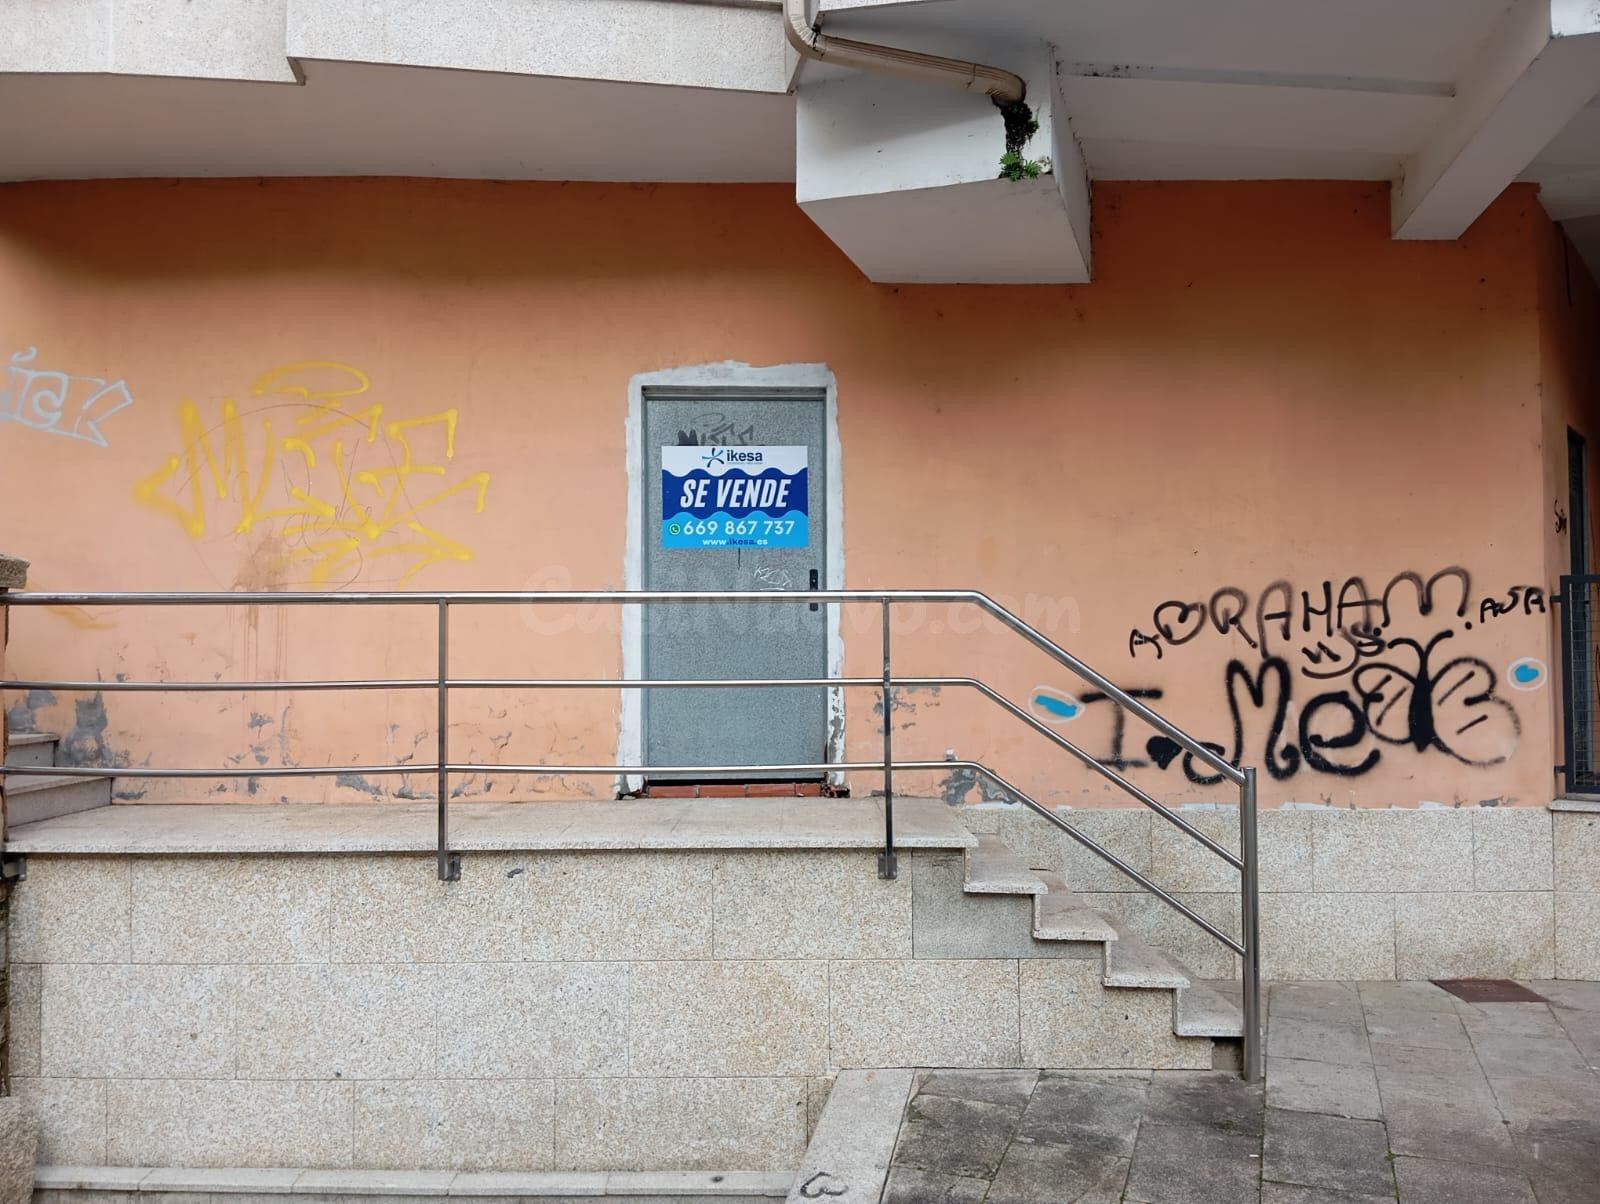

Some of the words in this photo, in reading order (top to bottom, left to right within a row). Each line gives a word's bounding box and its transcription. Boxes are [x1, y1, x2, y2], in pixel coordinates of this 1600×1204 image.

[727, 450, 763, 462] ikesa
[680, 479, 710, 508] SE
[716, 479, 792, 508] VENDE
[684, 521, 718, 535] 669
[725, 521, 758, 535] 867
[764, 521, 795, 535] 737
[702, 537, 768, 545] www.ikesa.es
